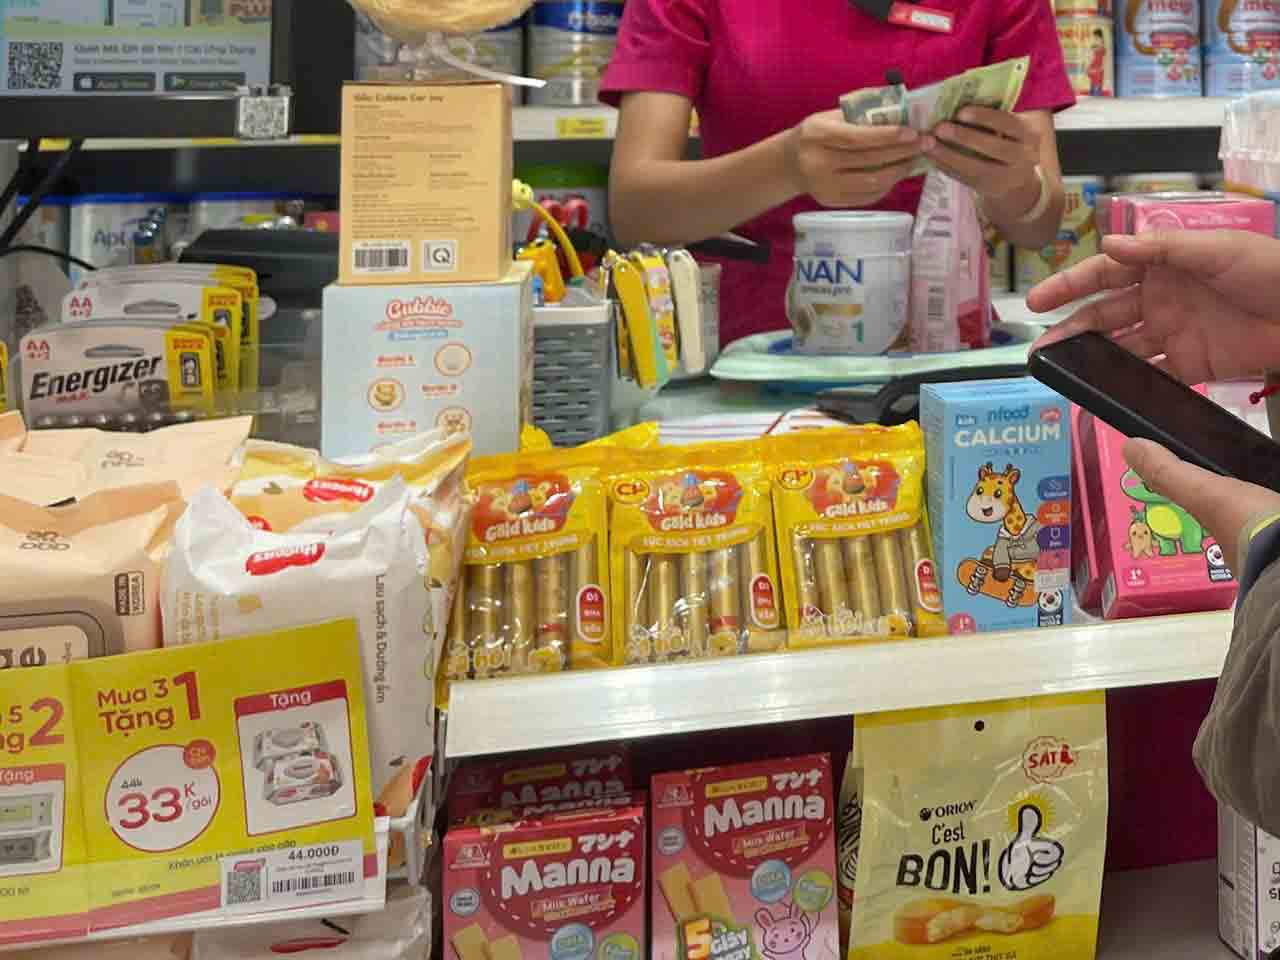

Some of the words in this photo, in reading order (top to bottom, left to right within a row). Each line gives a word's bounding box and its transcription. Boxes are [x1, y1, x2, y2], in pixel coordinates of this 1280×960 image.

[796, 259, 864, 283] NAN
[69, 295, 93, 310] AA
[26, 340, 50, 352] AA
[29, 355, 163, 401] Energizer
[954, 423, 1062, 448] CALCIUM
[97, 687, 146, 708] Mua
[153, 678, 169, 698] 3
[99, 705, 175, 737] Tặng
[173, 671, 201, 721] 1
[269, 689, 312, 708] Tặng
[10, 705, 23, 723] 5
[29, 696, 65, 746] 2
[117, 787, 183, 829] 33
[704, 794, 825, 838] Manna
[935, 800, 978, 819] ORION
[931, 821, 966, 845] C'est
[501, 855, 635, 900] Manna
[896, 840, 991, 896] BON!
